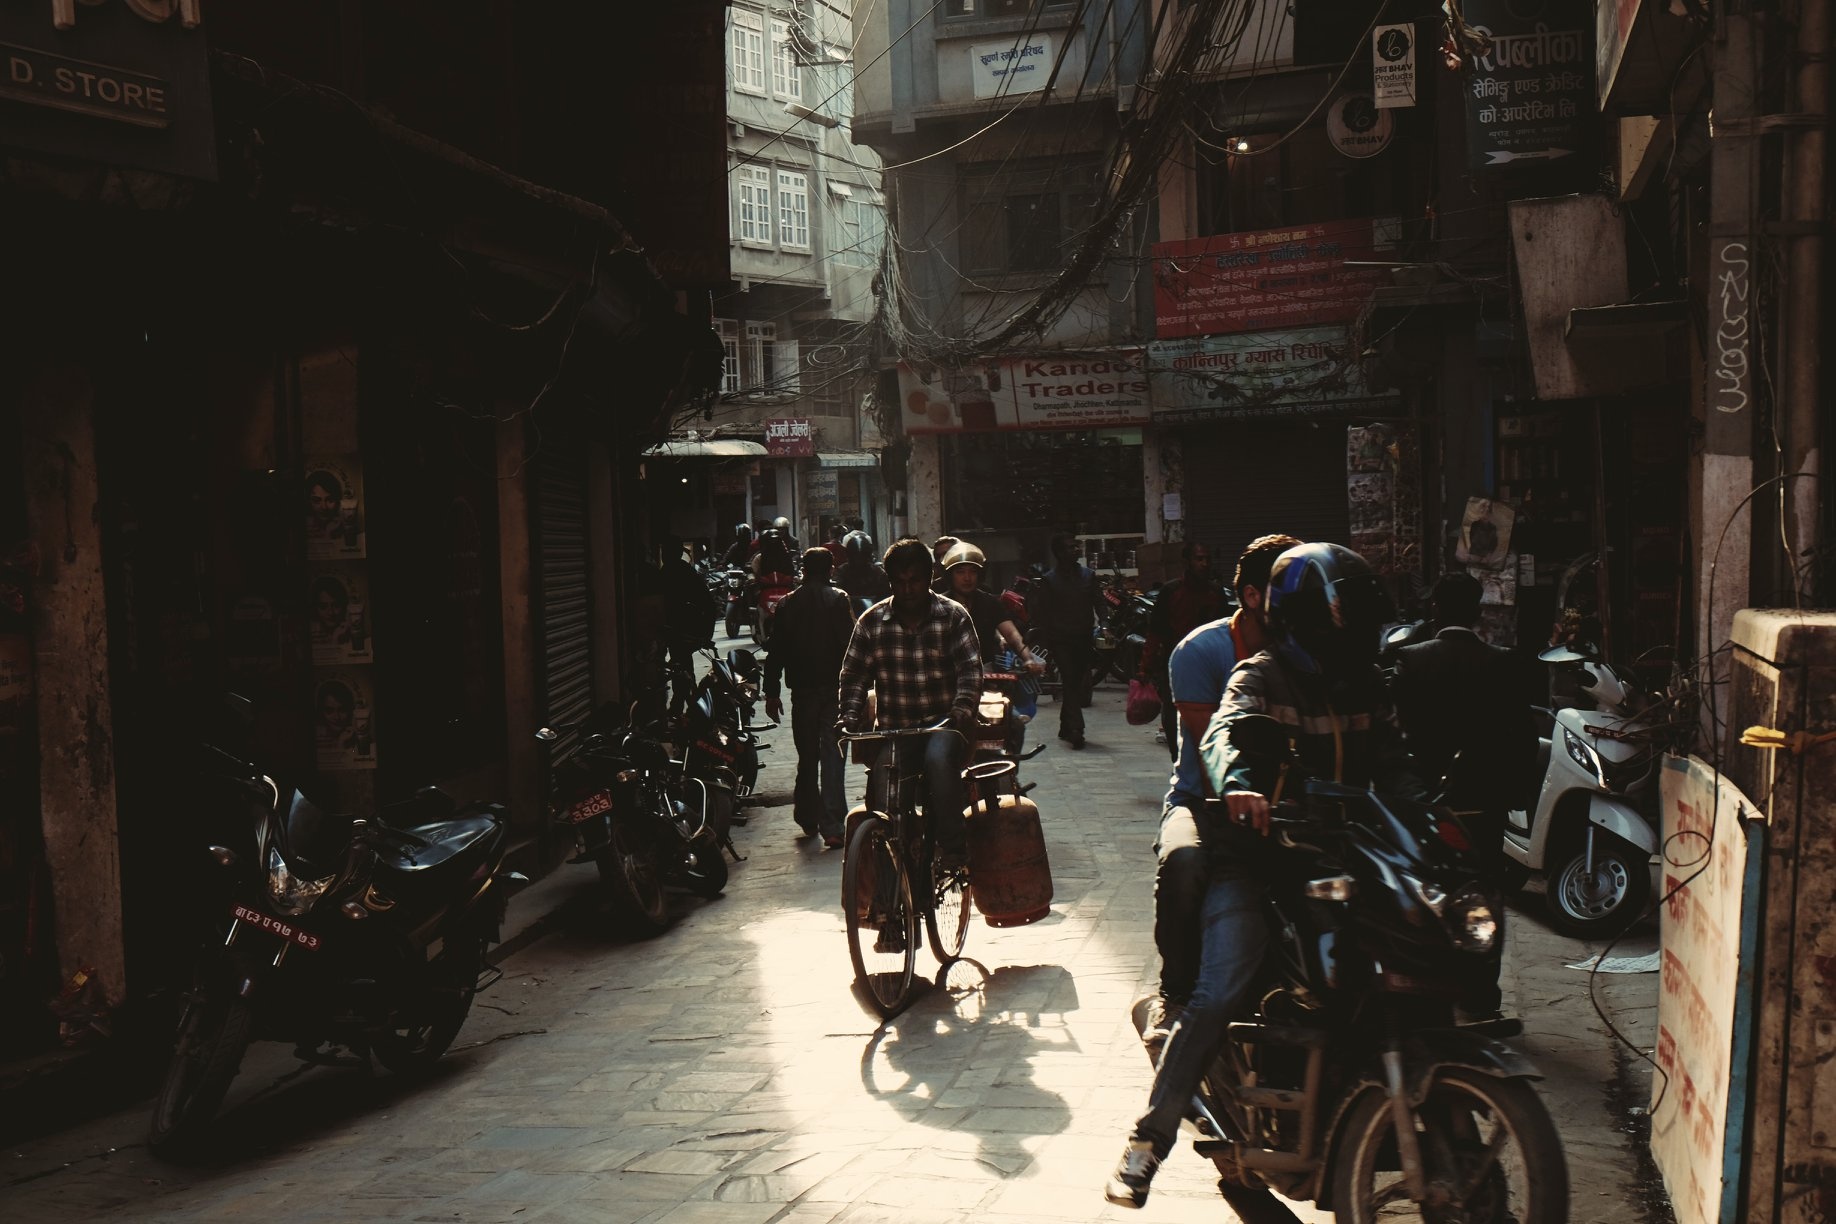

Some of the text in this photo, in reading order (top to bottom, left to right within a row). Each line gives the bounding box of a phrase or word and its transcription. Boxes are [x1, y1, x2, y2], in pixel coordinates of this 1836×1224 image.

[10, 56, 167, 113] D. STORE
[1375, 72, 1414, 82] Products
[1514, 80, 1541, 95] एण्ड
[1545, 72, 1585, 93] क्रेडिट
[1172, 351, 1237, 371] कान्तिपुर
[1245, 348, 1287, 364] ग्यास
[1022, 380, 1150, 398] Traders
